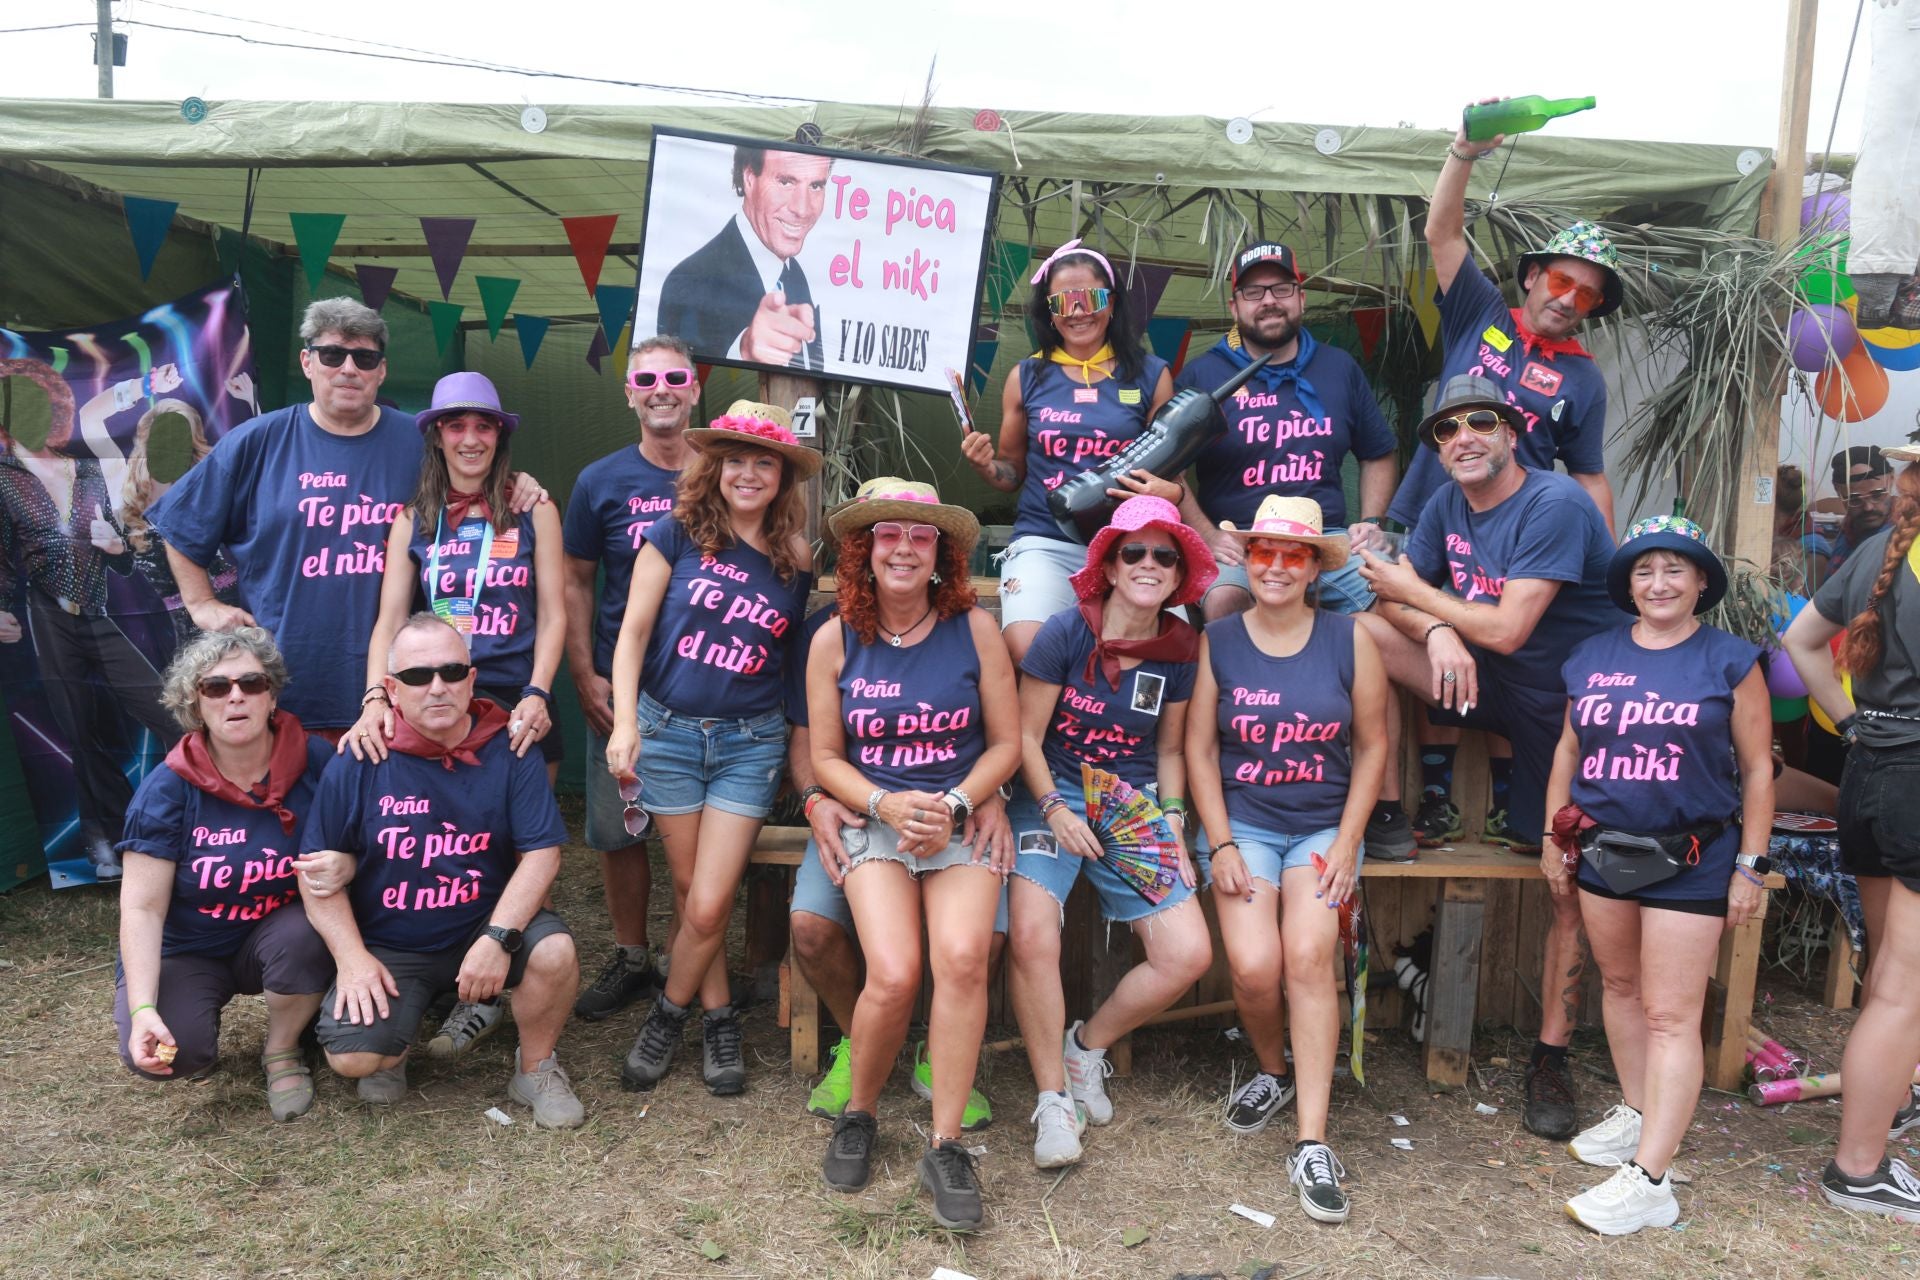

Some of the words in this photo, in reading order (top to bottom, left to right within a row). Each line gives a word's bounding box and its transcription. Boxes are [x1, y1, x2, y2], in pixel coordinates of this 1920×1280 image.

[830, 175, 871, 221] Te
[886, 188, 956, 236] pica
[828, 238, 864, 289] el
[882, 248, 939, 301] niki
[838, 319, 851, 361] Y
[852, 321, 876, 365] LO
[879, 324, 930, 373] SABES
[1040, 407, 1082, 423] Peña
[1236, 392, 1278, 410] Peña
[1038, 430, 1067, 457] Te
[1239, 417, 1270, 445] Te
[298, 472, 347, 490] Peña
[1243, 460, 1266, 487] el
[1270, 450, 1325, 484] niki
[298, 496, 334, 527] Te
[628, 496, 672, 514] Peña
[302, 546, 330, 578] el
[699, 555, 749, 583] Peña
[688, 577, 724, 611] Te
[722, 593, 790, 637] pica
[678, 631, 706, 659] el
[703, 635, 768, 676] niki
[851, 677, 901, 699] Peña
[1587, 672, 1637, 689] Peña
[1063, 686, 1106, 715] Peña
[1233, 686, 1280, 707] Peña
[848, 709, 886, 739] Te
[896, 702, 970, 736] pica
[1575, 693, 1612, 728] Te
[1618, 692, 1700, 735] pica
[1231, 714, 1267, 744] Te
[1271, 711, 1341, 753] pica
[1235, 759, 1263, 784] el
[1583, 747, 1606, 780] el
[1610, 743, 1685, 782] niki
[378, 795, 429, 817] Peña
[192, 826, 246, 847] Peña
[377, 827, 417, 861] Te
[421, 821, 491, 868] pica
[192, 856, 232, 890] Te
[240, 848, 299, 894] pic
[382, 880, 407, 910] el
[414, 869, 484, 910] niki
